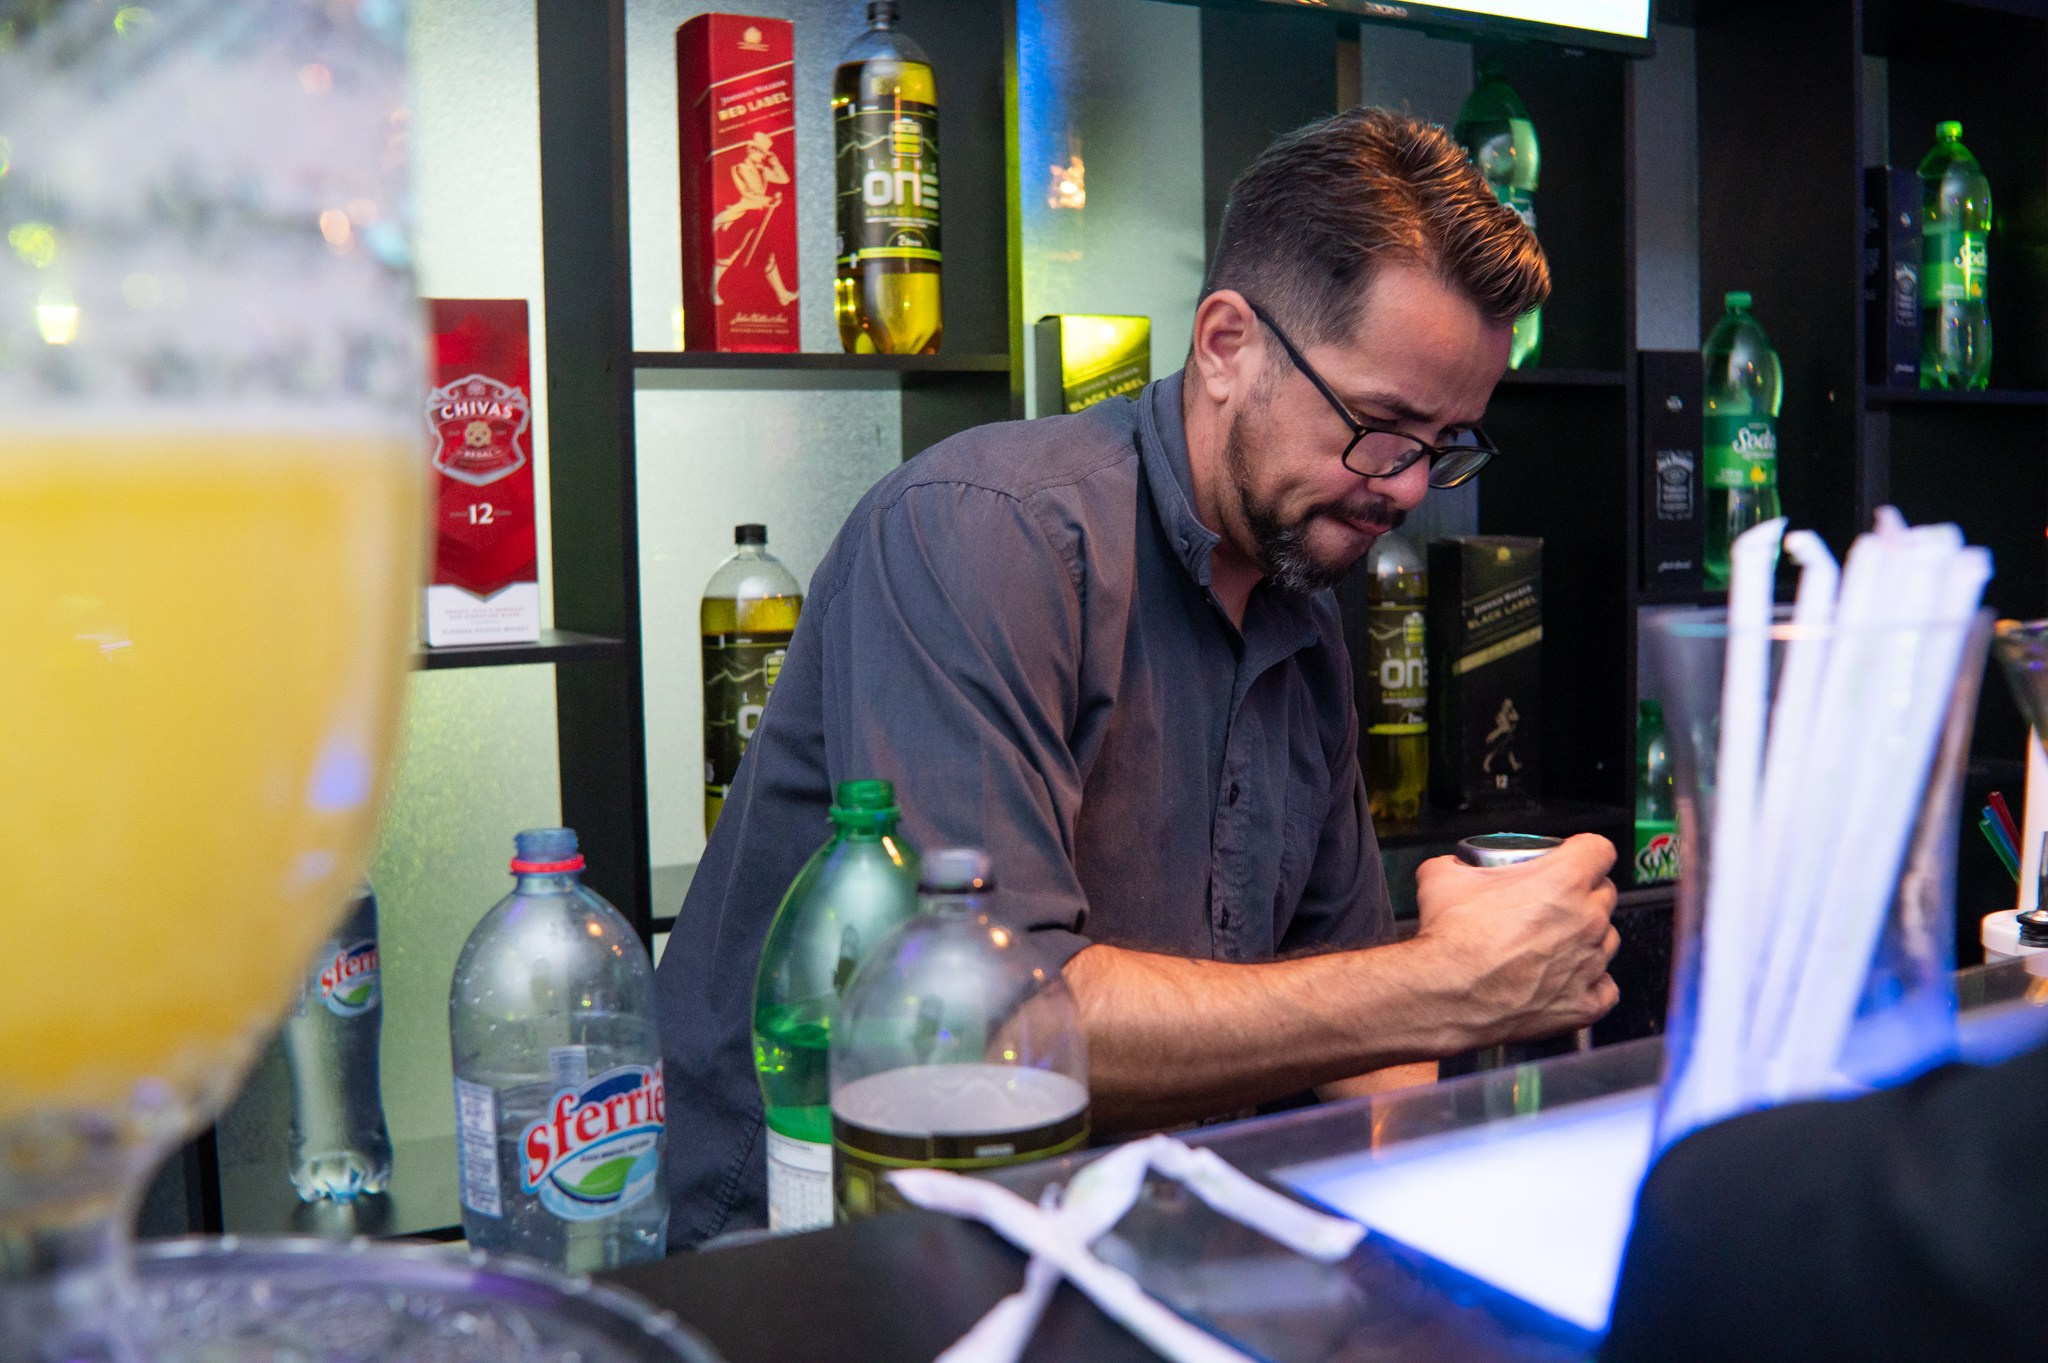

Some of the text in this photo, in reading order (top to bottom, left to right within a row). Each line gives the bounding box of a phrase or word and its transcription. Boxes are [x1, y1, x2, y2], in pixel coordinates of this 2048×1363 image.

[718, 104, 747, 121] RED
[746, 92, 791, 112] LABEL
[440, 400, 514, 420] CHIVAS
[468, 502, 495, 525] 12
